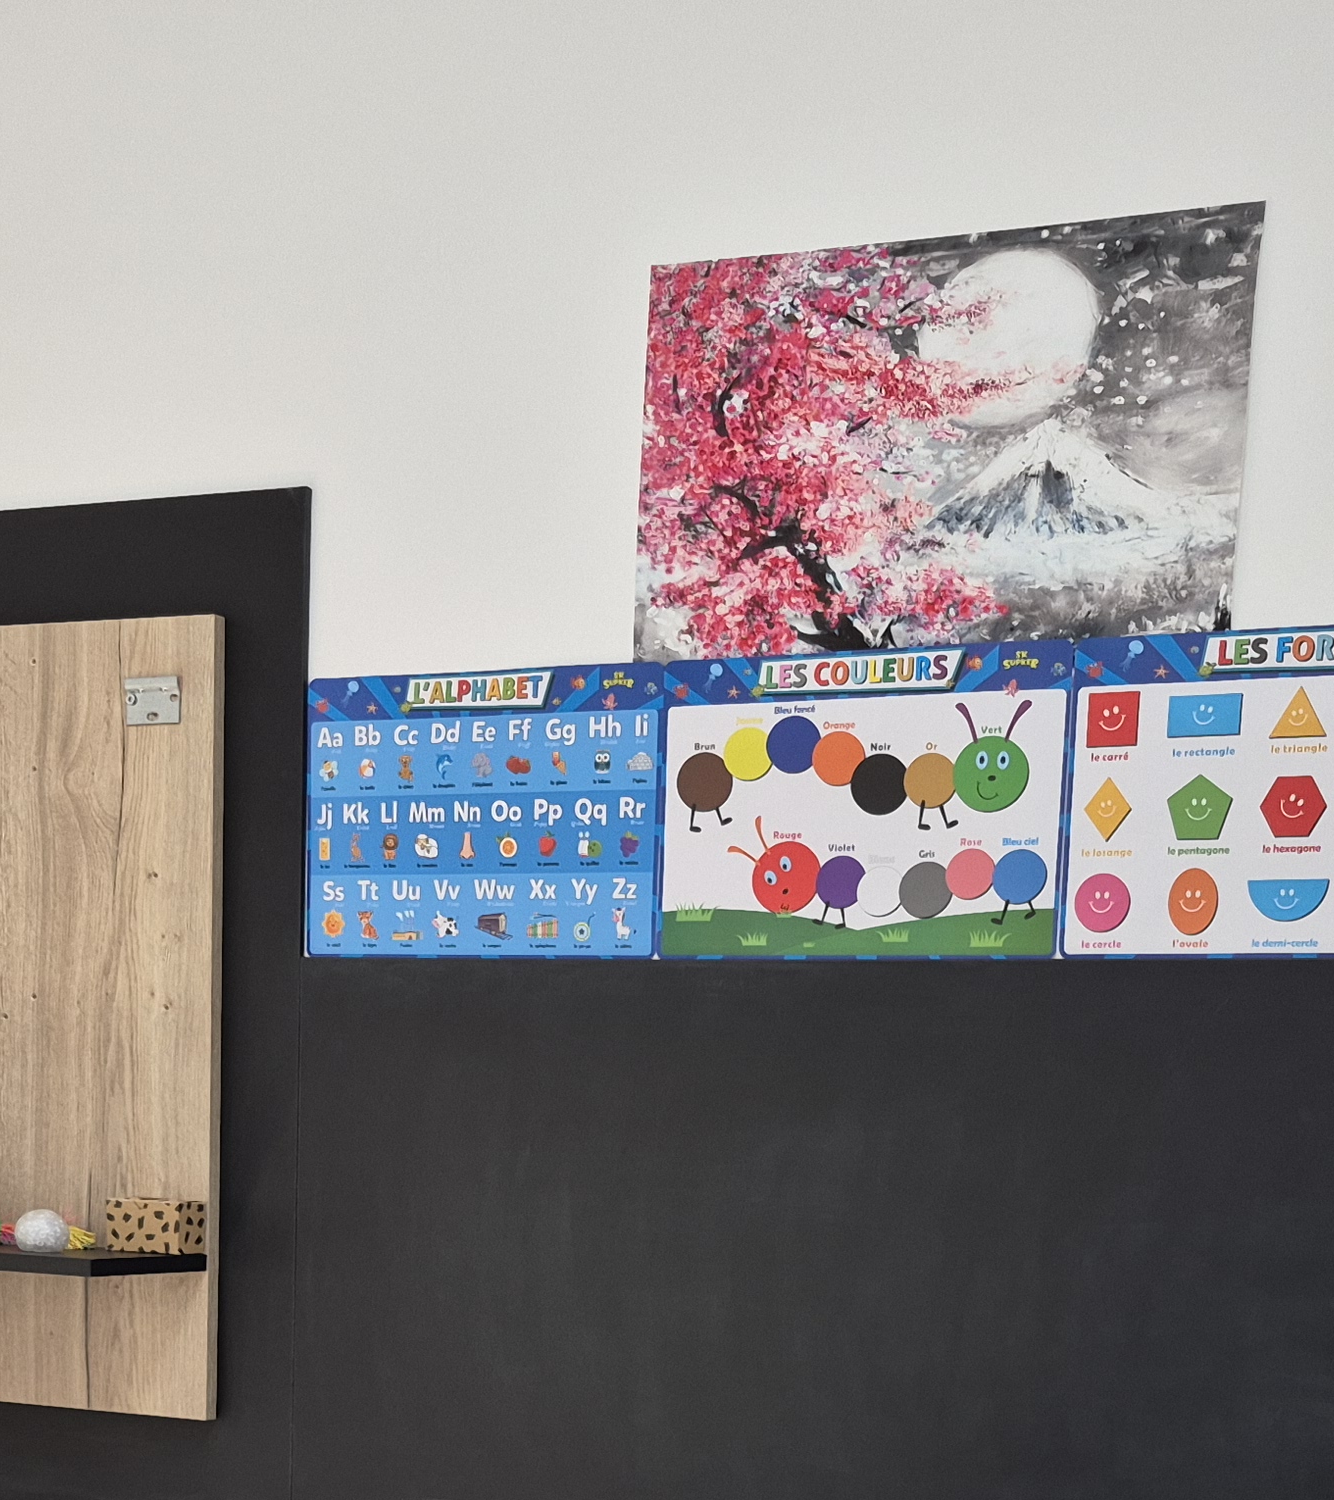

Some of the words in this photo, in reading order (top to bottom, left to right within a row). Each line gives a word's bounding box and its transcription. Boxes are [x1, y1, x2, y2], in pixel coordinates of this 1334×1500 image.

[1217, 637, 1268, 666] LES
[766, 663, 807, 689] LES
[814, 654, 949, 687] COULEURS
[412, 675, 543, 705] L'ALPHABET
[774, 706, 792, 715] Bleu
[823, 721, 856, 730] Orange
[981, 726, 1002, 734] Vert
[317, 727, 343, 748] Aa
[354, 724, 381, 746] Bb
[394, 725, 419, 746] Cc
[430, 720, 460, 743] Dd
[472, 721, 496, 742] Ee
[508, 718, 532, 741] Ff
[545, 718, 576, 745] Gg
[589, 714, 621, 738] Hh
[694, 743, 715, 751] Brun
[870, 742, 891, 751] Noir
[925, 742, 938, 751] Or
[1271, 745, 1280, 753] le
[1283, 743, 1328, 754] triangle
[1091, 753, 1101, 762] le
[1102, 752, 1129, 761] carré
[1172, 748, 1182, 757] le
[1184, 747, 1236, 757] rectangle
[317, 803, 333, 830] Jj
[342, 802, 369, 824] Kk
[409, 801, 445, 823] Mm
[453, 800, 481, 823] Nn
[491, 800, 522, 822] Oo
[534, 798, 563, 826] Pp
[575, 798, 607, 826] Qq
[619, 796, 645, 819] Rr
[773, 831, 802, 840] Rouge
[960, 838, 982, 846] Rose
[1002, 838, 1022, 846] Bleu
[1024, 837, 1039, 846] ciel
[828, 843, 855, 852] Violet
[1168, 847, 1176, 855] le
[1177, 846, 1230, 857] pentagone
[1262, 844, 1272, 853] le
[1273, 844, 1322, 854] hexagone
[919, 850, 935, 858] Gris
[1081, 849, 1091, 857] le
[1092, 848, 1132, 858] losange
[322, 880, 345, 901] Ss
[357, 880, 379, 901] Tt
[392, 879, 421, 901] Uu
[433, 879, 461, 900] Vv
[473, 879, 515, 900] Ww
[529, 878, 557, 900] Xx
[571, 878, 598, 905] Yy
[612, 877, 637, 900] Zz
[1081, 940, 1090, 949] le
[1092, 939, 1122, 949] cercle
[1172, 939, 1209, 948] l'ovale
[1251, 939, 1260, 948] le
[1262, 938, 1318, 948] demi-cercle
